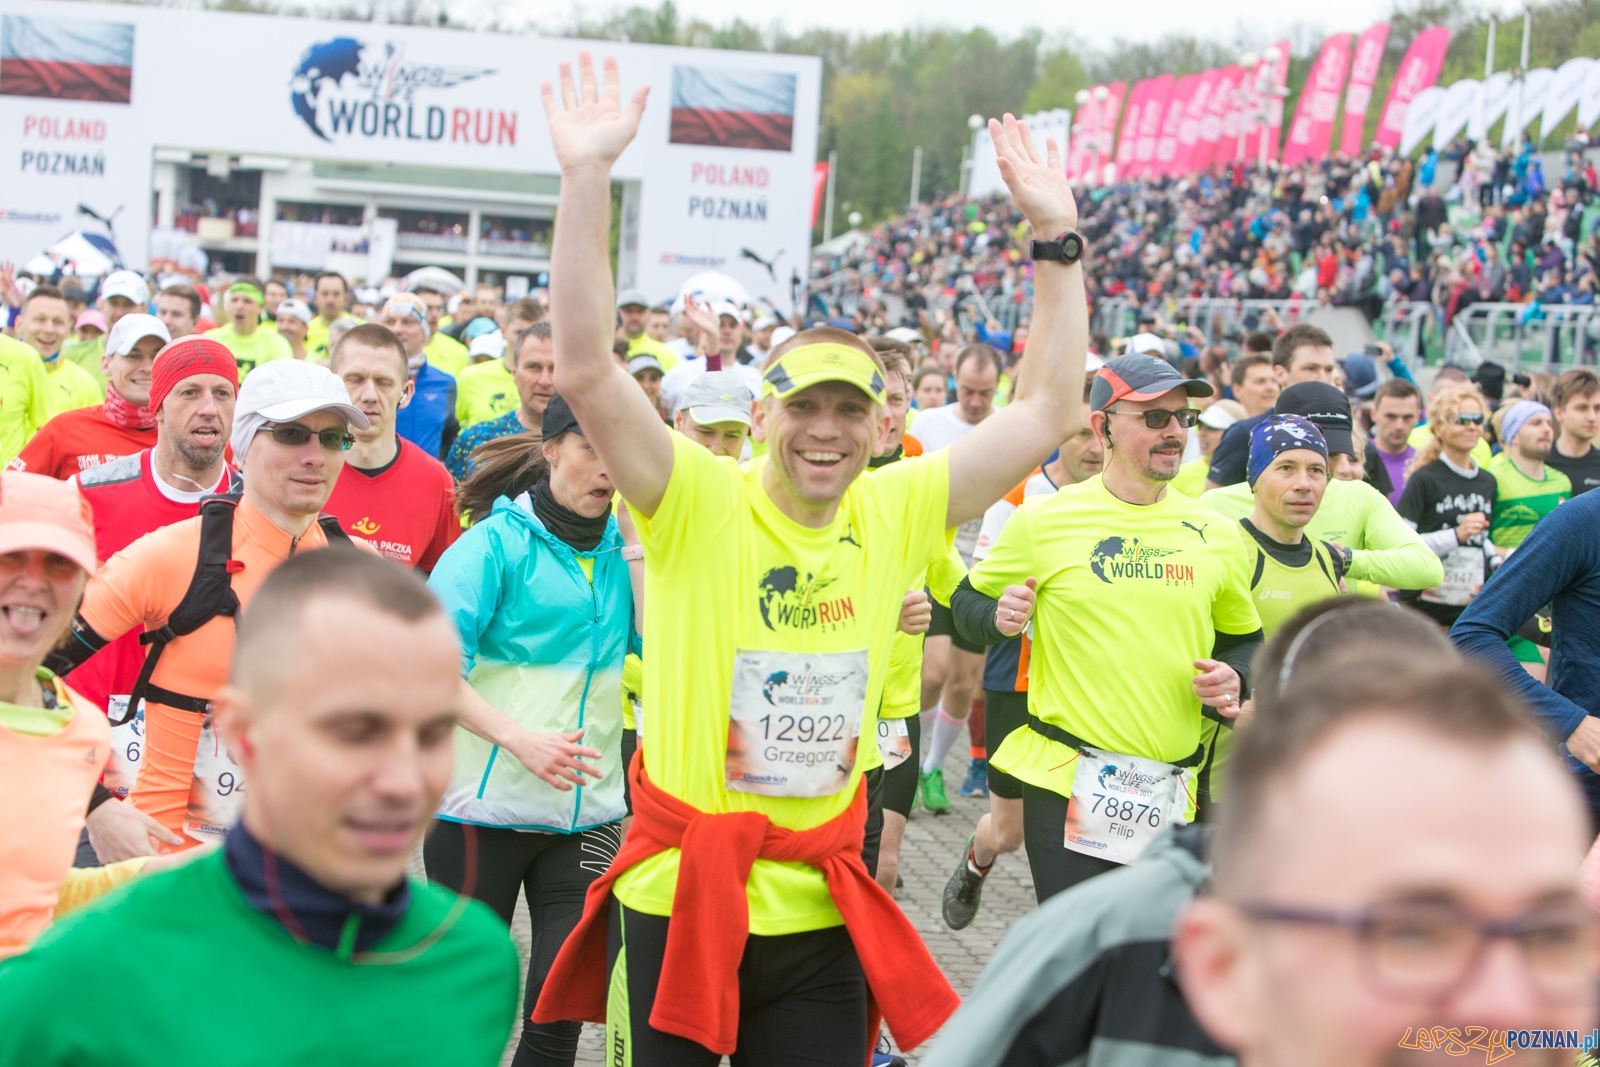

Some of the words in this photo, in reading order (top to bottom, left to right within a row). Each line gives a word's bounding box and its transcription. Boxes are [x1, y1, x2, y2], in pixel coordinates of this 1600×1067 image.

[24, 115, 106, 142] POLAND
[21, 149, 105, 175] POZNAŃ
[691, 162, 768, 188] POLAND
[688, 195, 767, 221] POZNAŃ
[380, 540, 412, 555] PACZKA
[1124, 547, 1160, 557] WINGS
[384, 551, 411, 561] BIEGOWA
[1129, 555, 1150, 563] LIFE
[1110, 562, 1163, 579] WORLD
[1165, 564, 1193, 582] RUN
[1270, 590, 1292, 600] asics
[818, 596, 855, 625] RUN
[791, 674, 835, 685] WINGS
[796, 685, 822, 695] LIFE
[778, 696, 804, 705] WORLD
[804, 697, 819, 705] RUN
[820, 696, 834, 705] 2017
[759, 713, 846, 743] 12922
[764, 745, 836, 767] Grzegorz
[729, 771, 787, 783] BFGoodrich
[1119, 769, 1155, 783] WINGS
[1108, 782, 1127, 793] WORLD
[1127, 788, 1139, 796] RUN
[1139, 789, 1153, 798] 2017
[1121, 779, 1142, 789] LIFE
[1091, 793, 1161, 828] 78876
[1108, 822, 1135, 840] Filip
[1067, 834, 1108, 849] BFGoodrich
